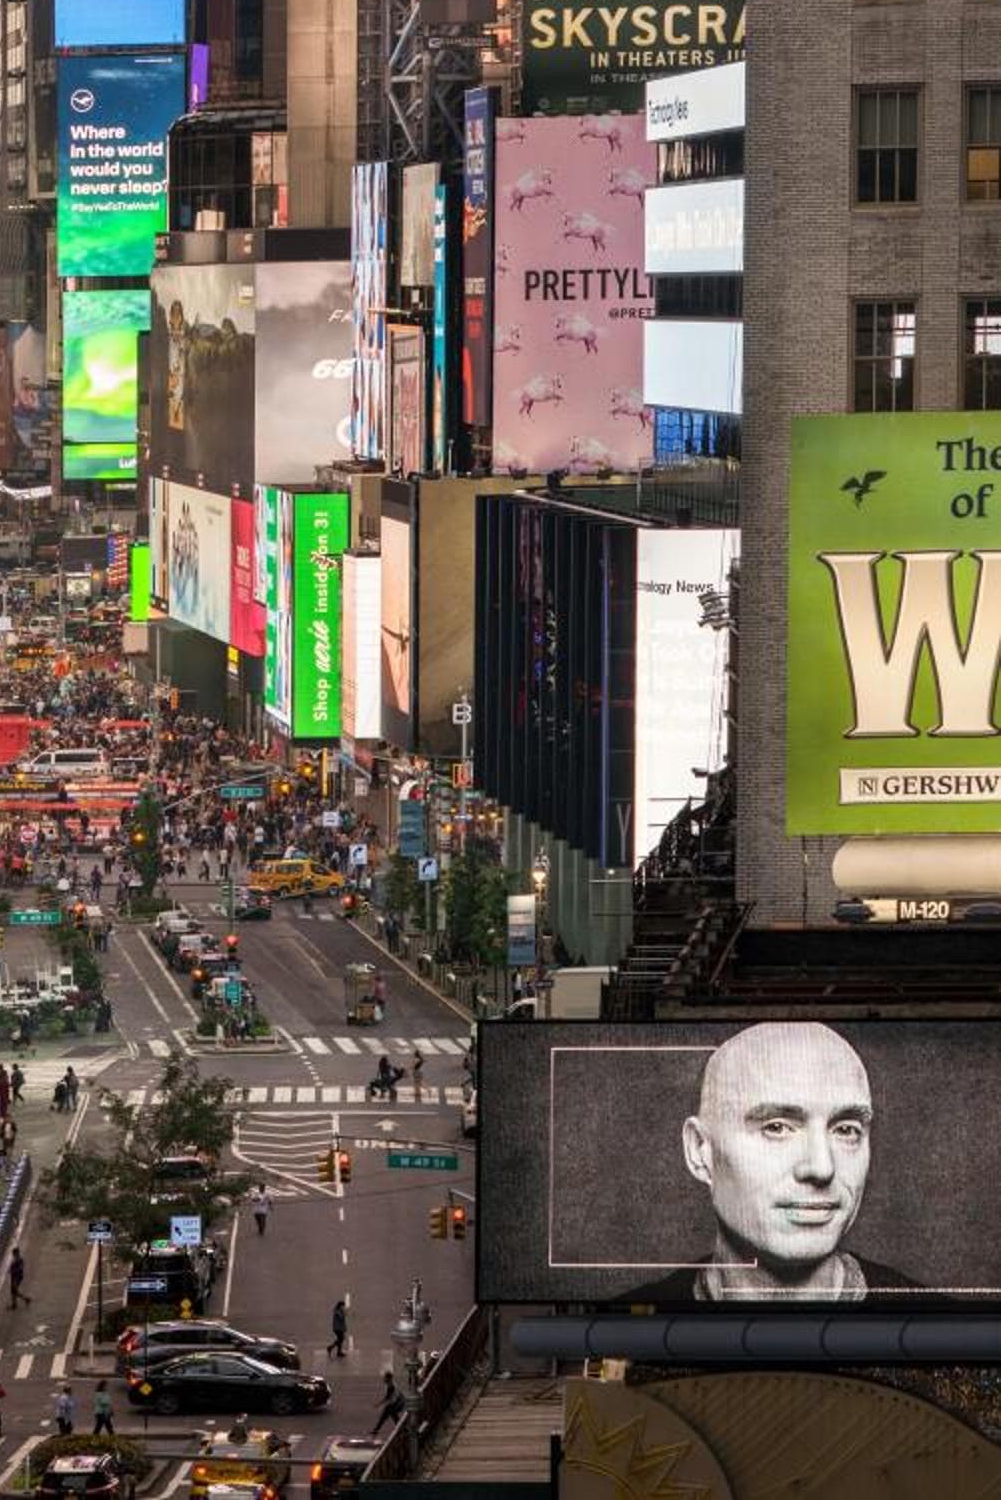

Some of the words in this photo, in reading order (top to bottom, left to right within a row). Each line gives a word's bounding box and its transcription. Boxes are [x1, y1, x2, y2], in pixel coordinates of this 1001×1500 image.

[590, 51, 609, 68] IN
[617, 49, 715, 69] THEATERS
[70, 124, 126, 140] Where
[70, 144, 86, 159] in
[88, 143, 115, 158] the
[117, 141, 164, 157] world
[70, 161, 120, 177] would
[122, 163, 153, 179] you
[70, 182, 117, 196] never
[936, 436, 1001, 474] The
[950, 482, 995, 520] of
[676, 579, 715, 593] News
[816, 549, 1001, 740] W
[312, 678, 331, 722] Shop
[881, 775, 1001, 798] GERSHW
[899, 901, 950, 920] M-120
